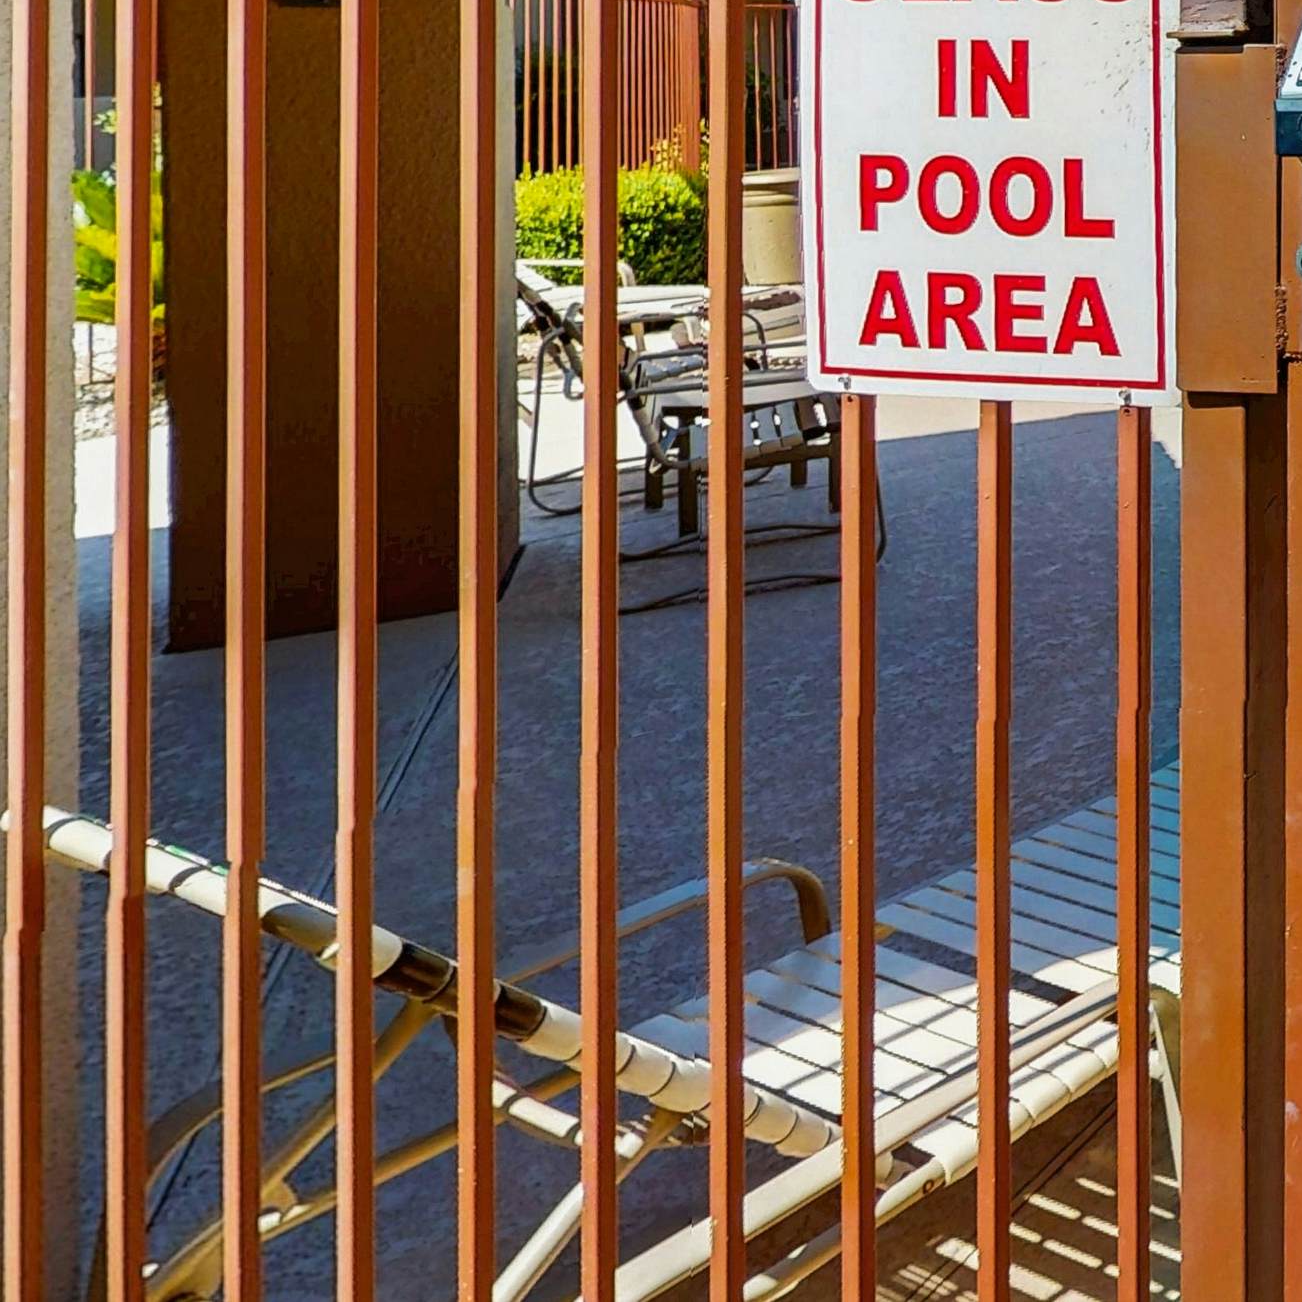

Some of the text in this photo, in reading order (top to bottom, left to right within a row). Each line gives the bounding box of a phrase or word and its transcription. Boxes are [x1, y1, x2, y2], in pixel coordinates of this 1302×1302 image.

[938, 40, 1029, 118] IN
[860, 155, 1114, 238] POOL
[860, 271, 1120, 356] AREA
